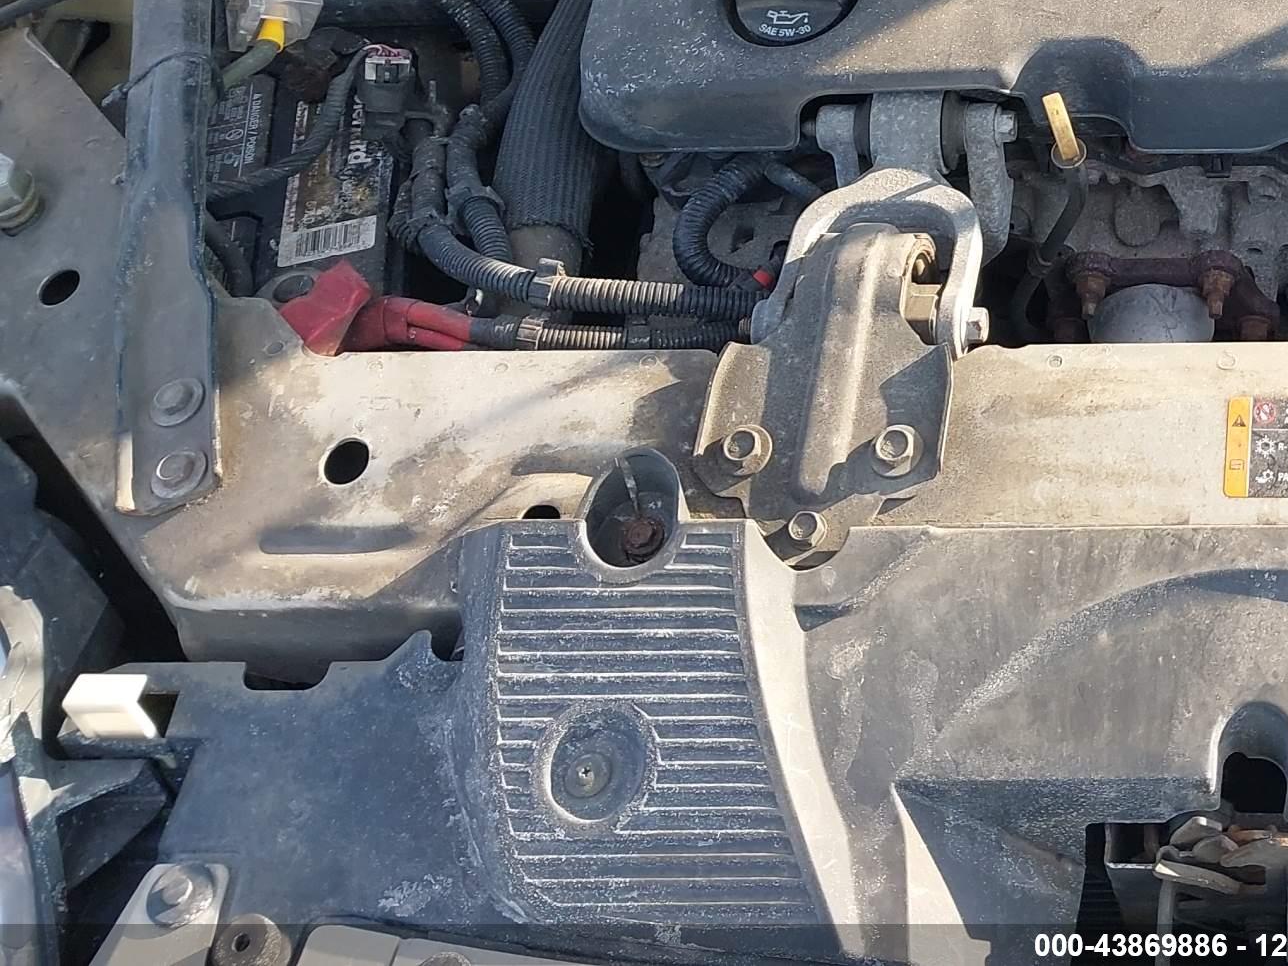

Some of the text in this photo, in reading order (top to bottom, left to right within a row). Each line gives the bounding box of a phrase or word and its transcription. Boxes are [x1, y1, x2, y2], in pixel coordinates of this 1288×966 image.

[759, 24, 812, 37] SAE 5W-30
[248, 99, 262, 130] DANGER
[244, 136, 257, 164] POISON
